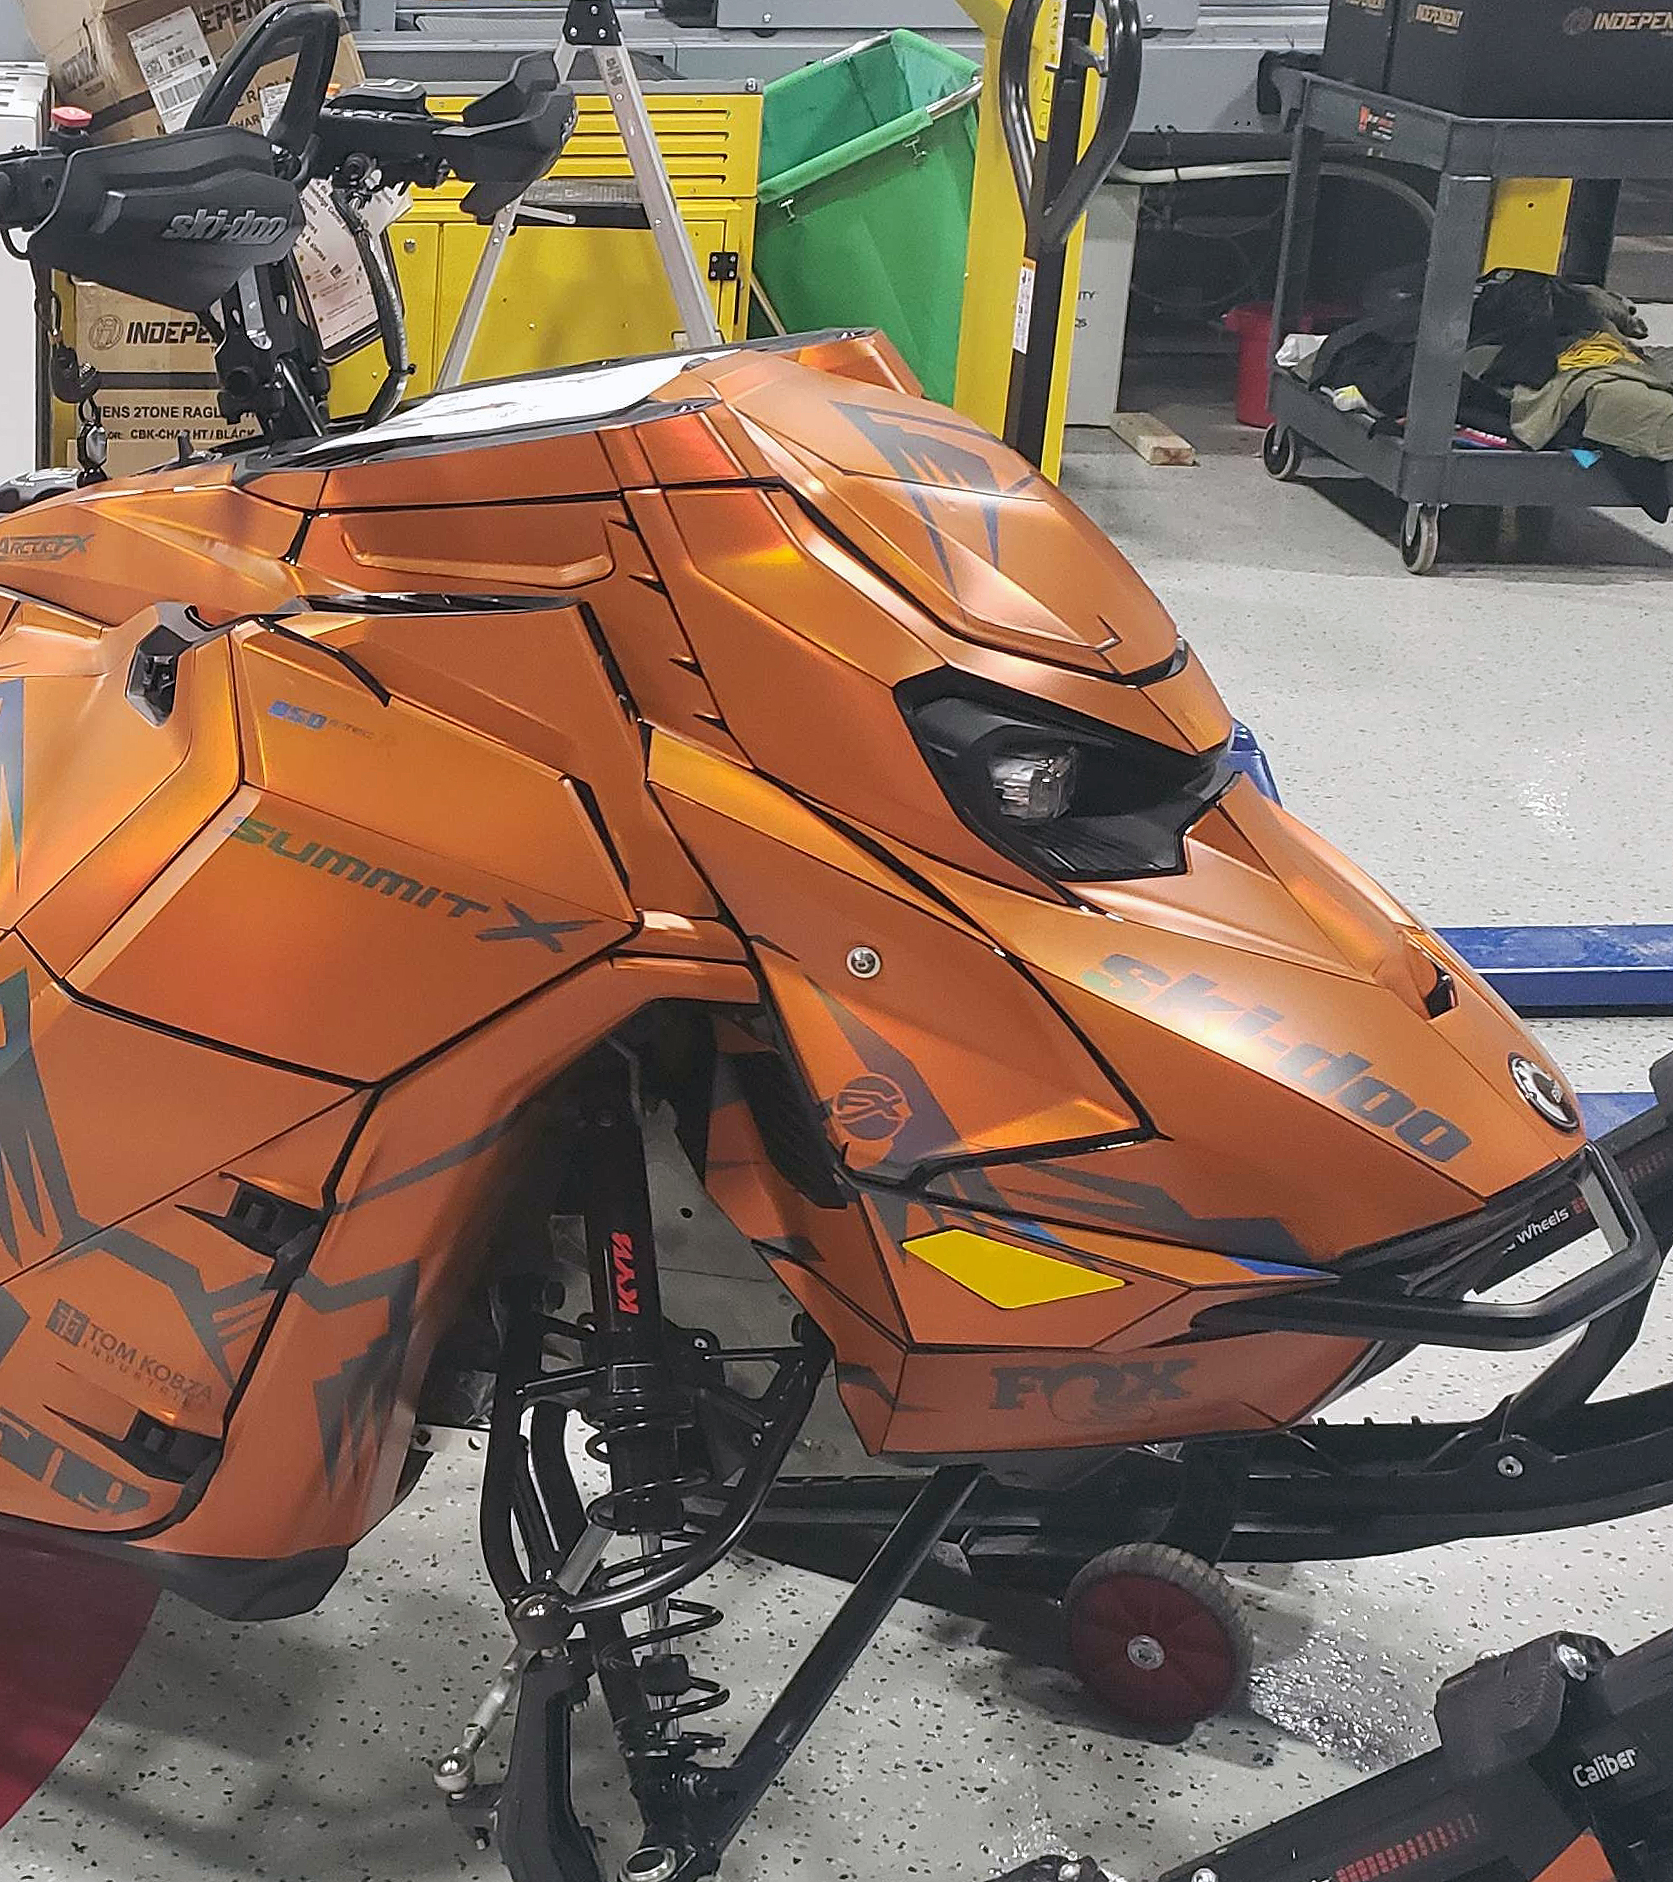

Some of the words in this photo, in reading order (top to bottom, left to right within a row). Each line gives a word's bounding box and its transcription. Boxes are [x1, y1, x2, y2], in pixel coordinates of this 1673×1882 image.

[1593, 11, 1673, 30] INDEPEN
[126, 321, 212, 344] INDEPE
[133, 406, 179, 419] 2TONE
[224, 815, 491, 918] SUMMIT
[1081, 953, 1473, 1163] ski-doo
[1516, 1206, 1570, 1245] Wheels
[89, 1322, 138, 1366] TOM
[989, 1359, 1199, 1416] FOX
[1572, 1747, 1637, 1788] Caliber
